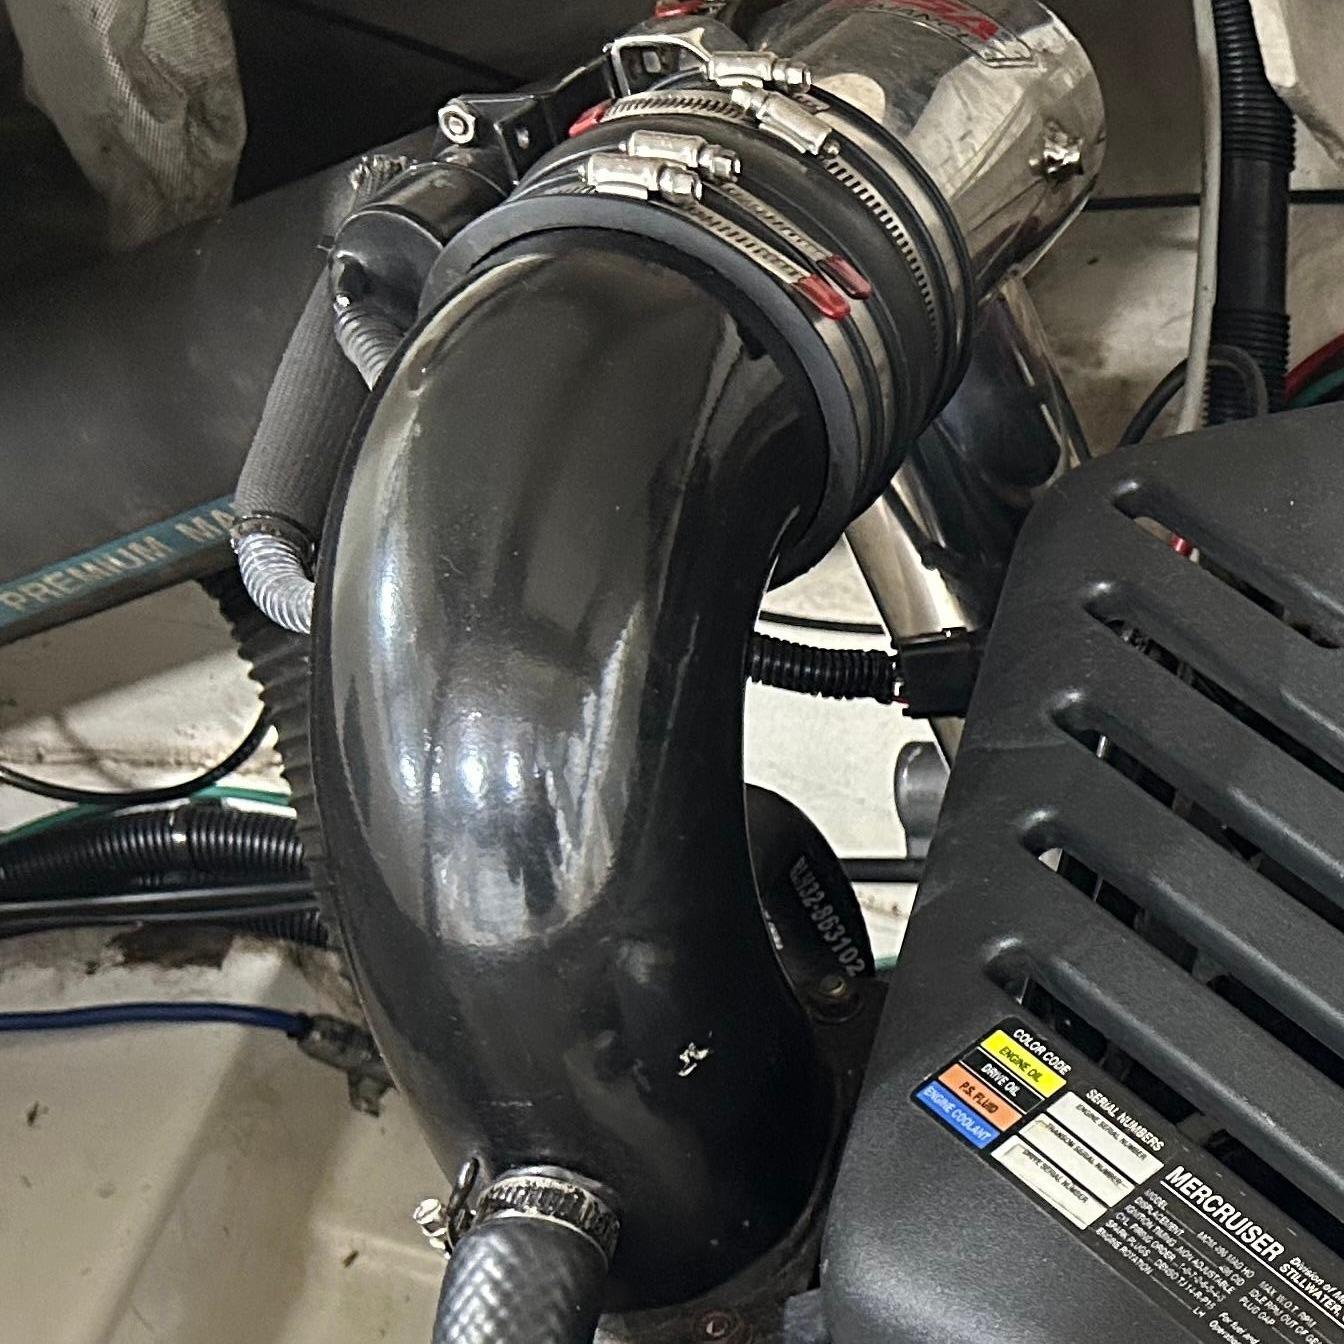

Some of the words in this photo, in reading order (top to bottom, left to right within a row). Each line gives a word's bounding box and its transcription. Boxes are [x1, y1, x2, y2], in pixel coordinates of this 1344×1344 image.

[1, 535, 172, 611] PREMIUM
[175, 508, 235, 542] MA
[999, 1047, 1030, 1070] ENGINE
[1027, 1069, 1043, 1081] OIL
[1012, 1029, 1046, 1054] COLOR
[1041, 1052, 1071, 1074] CODE
[981, 1064, 1008, 1085] DRIVE
[1003, 1081, 1022, 1096] OIL
[923, 1087, 955, 1111] ENGINE
[950, 1109, 990, 1140] COOLANT
[972, 1093, 998, 1113] FLUID
[1085, 1089, 1120, 1116] SERIAL
[1116, 1113, 1165, 1151] NUMBERS
[1166, 1167, 1284, 1259] MERCRUISER
[1289, 1256, 1326, 1285] Division
[1322, 1282, 1336, 1293] of
[1218, 1311, 1233, 1323] For
